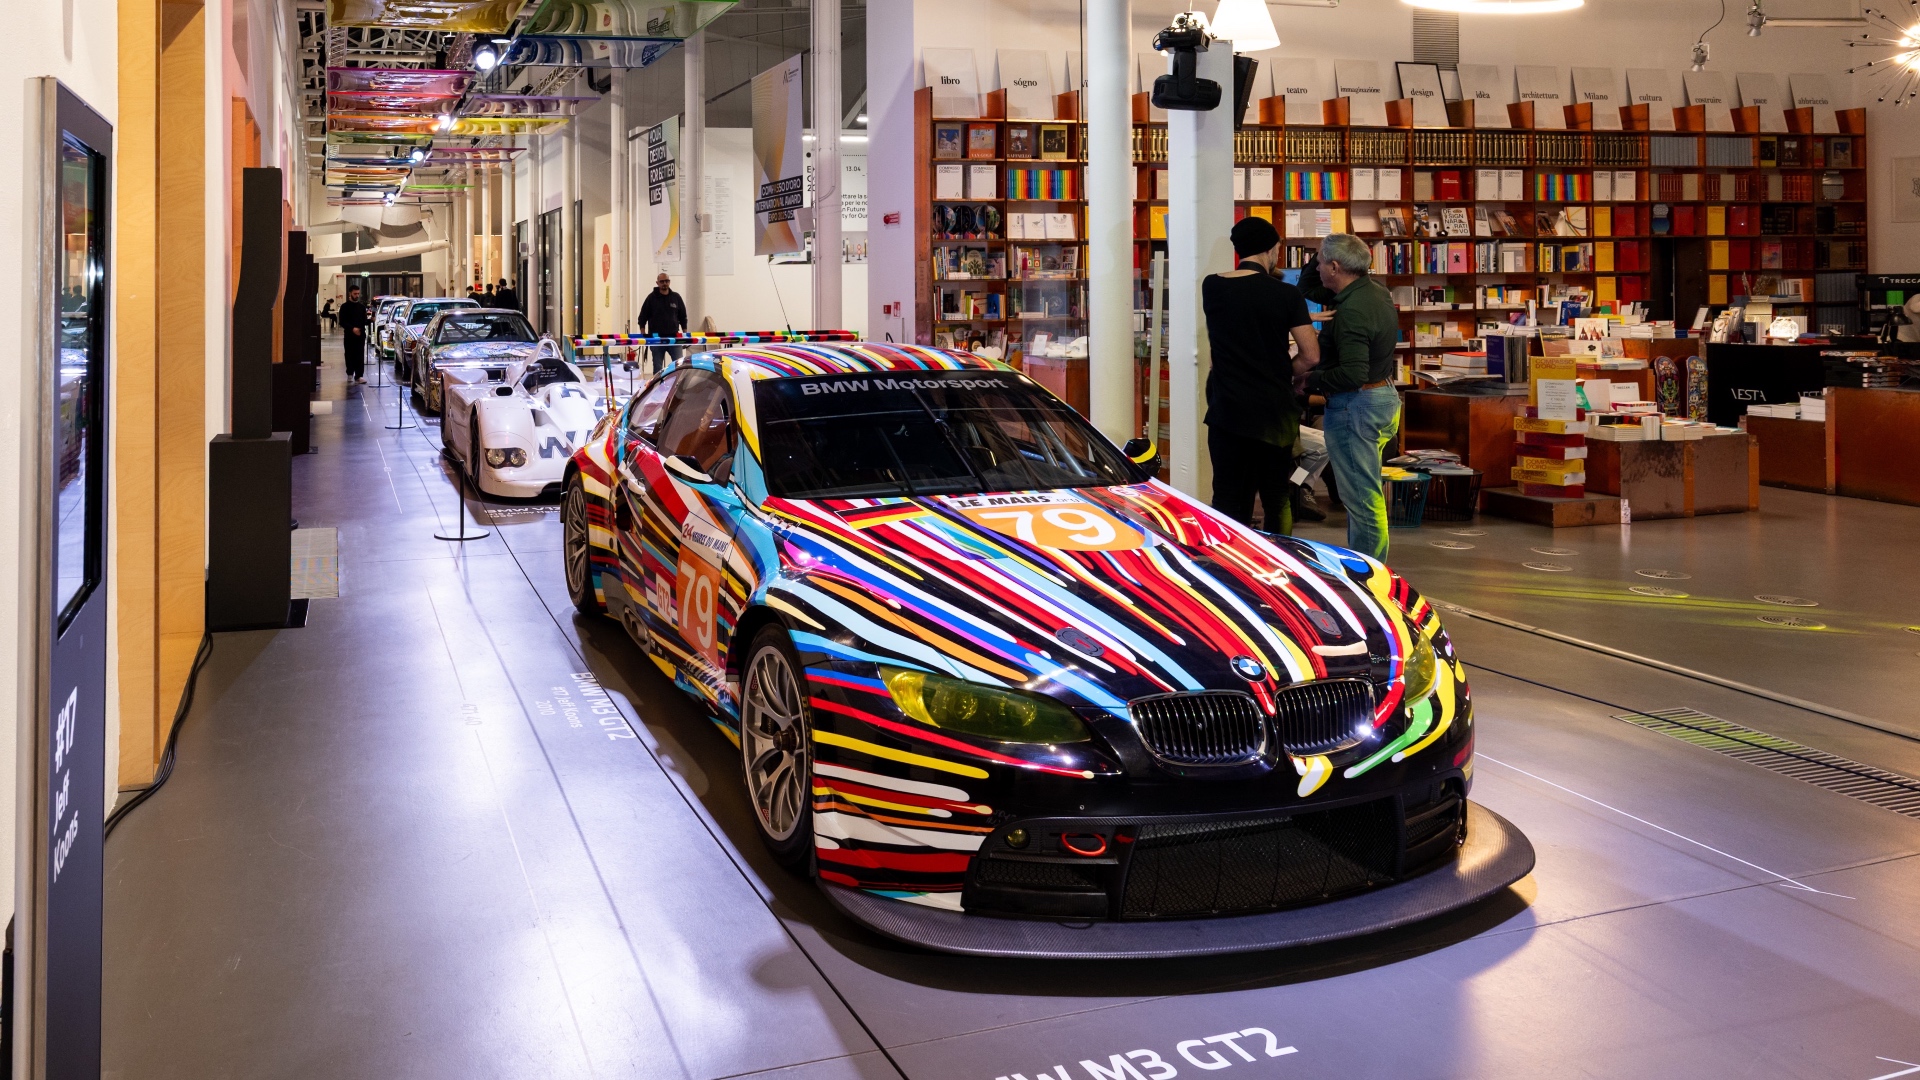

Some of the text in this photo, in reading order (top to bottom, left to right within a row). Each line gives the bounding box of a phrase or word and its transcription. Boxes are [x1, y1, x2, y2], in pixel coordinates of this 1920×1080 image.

[941, 76, 960, 85] libro
[1410, 88, 1434, 97] design
[1521, 91, 1559, 99] architettura
[1639, 94, 1662, 102] cultura
[649, 145, 666, 163] DESIGN
[658, 163, 675, 179] BETTER
[786, 178, 801, 191] D'ORO
[756, 193, 802, 212] INTERNATIONAL AWARD
[800, 374, 1009, 396] BMW Motorsport
[1515, 418, 1549, 427] COMPASSO
[1512, 468, 1548, 477] COMPASSO
[957, 499, 983, 508] LE
[987, 495, 1051, 506] MANS
[978, 508, 1117, 547] 79
[682, 523, 729, 553] 24 HEURES DU MANS
[657, 582, 671, 618] GT2
[680, 560, 713, 649] 79
[535, 700, 557, 716] 2010
[554, 696, 575, 710] Jeff
[570, 672, 637, 741] BMW M3 GT2
[562, 706, 583, 729] Koons
[55, 685, 78, 774] #17
[53, 768, 70, 836] Jeff
[53, 809, 79, 884] Koons
[1078, 1049, 1178, 1080] M3
[1176, 1027, 1299, 1070] GT2
